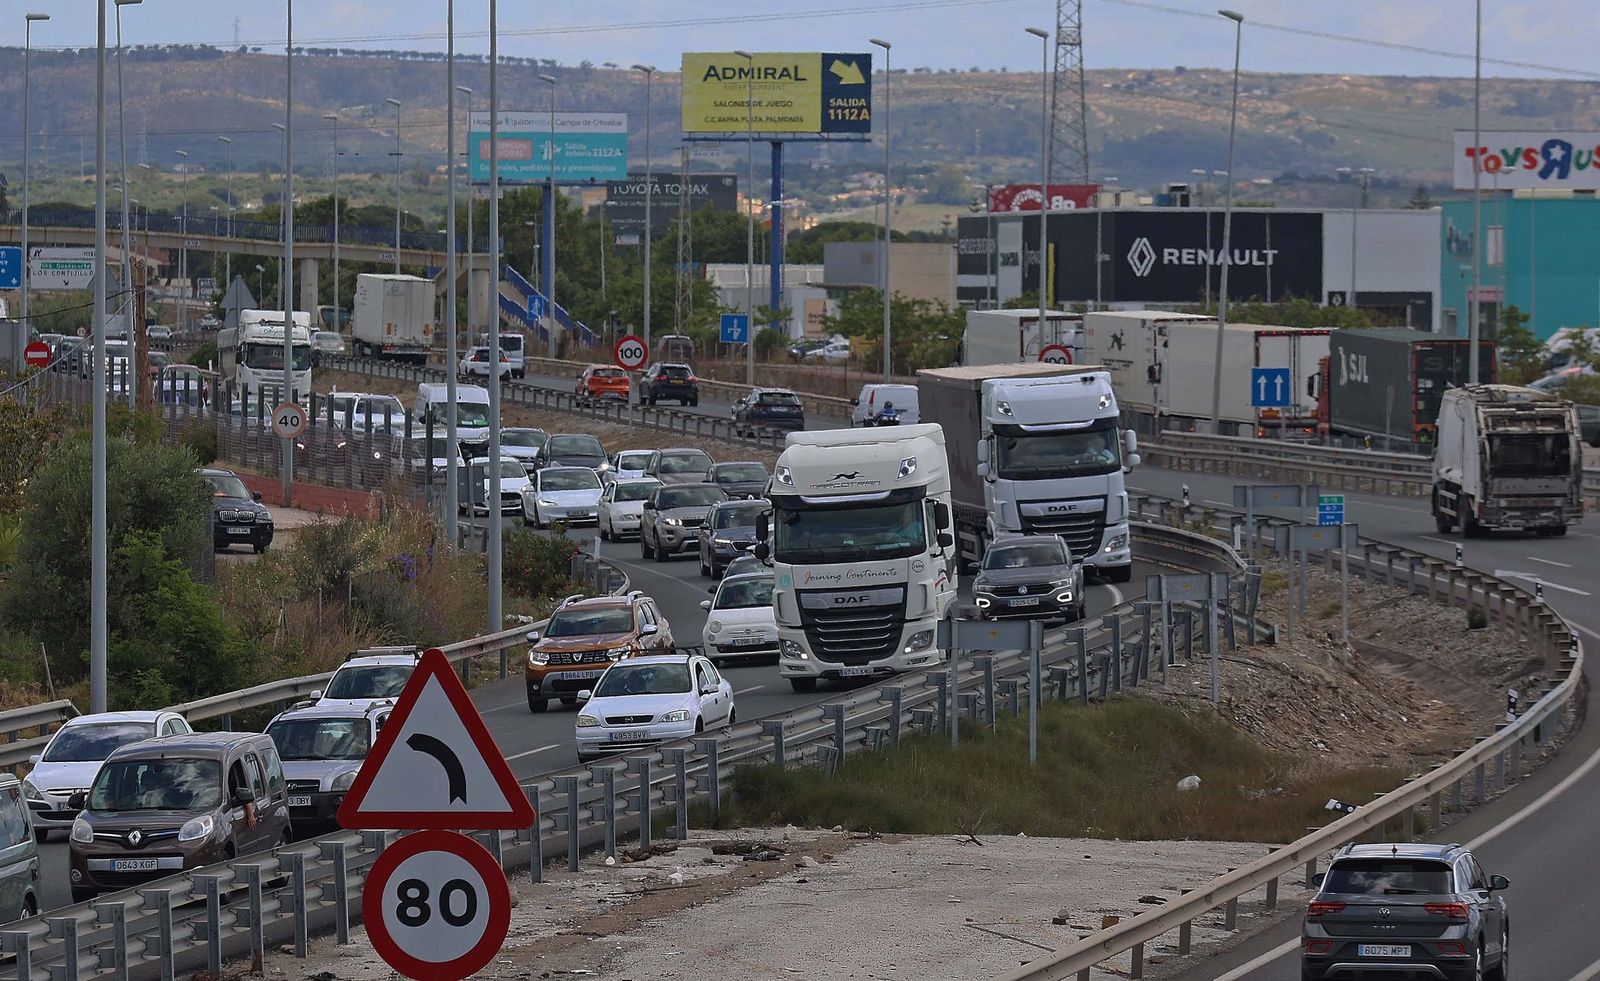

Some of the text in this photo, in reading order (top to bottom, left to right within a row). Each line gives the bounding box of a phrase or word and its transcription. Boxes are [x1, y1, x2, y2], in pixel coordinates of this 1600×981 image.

[703, 65, 807, 82] ADMIRAL
[713, 100, 793, 108] SALONES DE JUEGO
[829, 98, 867, 107] SALIDA
[828, 108, 870, 121] 1112A
[613, 183, 661, 194] TOYOTA
[1163, 248, 1278, 266] RENAULT
[620, 347, 643, 359] 100
[279, 415, 299, 427] 40
[1048, 504, 1078, 512] DAF
[804, 567, 897, 585] Joining Continents
[834, 595, 870, 604] DAF
[395, 878, 478, 928] 80
[1365, 946, 1409, 956] 6075 MPT
